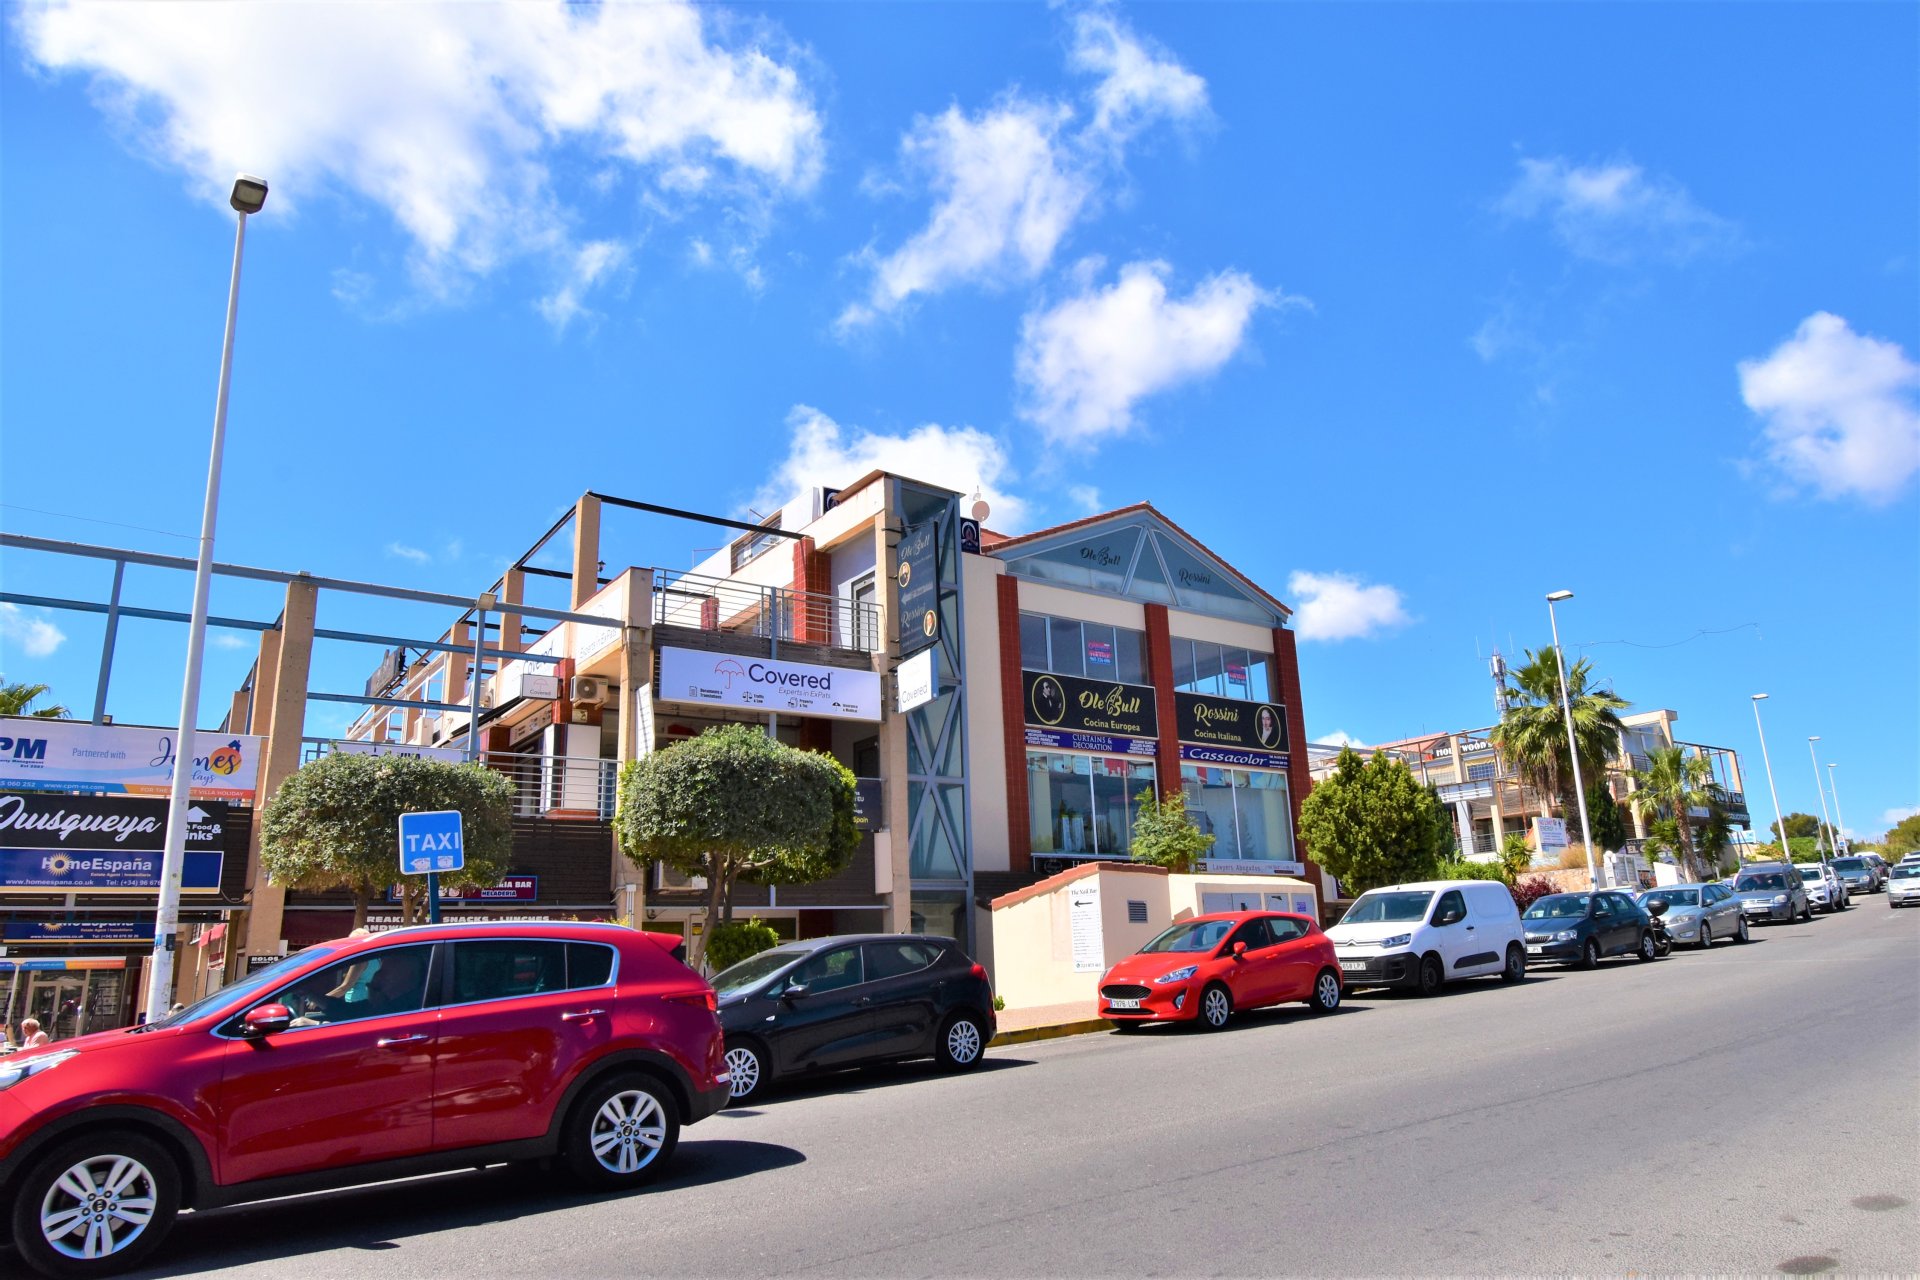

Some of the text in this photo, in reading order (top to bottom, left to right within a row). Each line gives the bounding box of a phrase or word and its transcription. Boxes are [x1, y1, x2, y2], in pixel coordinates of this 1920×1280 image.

[1080, 547, 1120, 566] Ole Bull
[1179, 568, 1210, 586] Rossini
[748, 663, 831, 690] Covered
[778, 687, 803, 696] Experts
[810, 691, 831, 699] ExPats
[902, 681, 928, 703] Covered
[1079, 687, 1140, 716] Ole Bull
[1193, 703, 1239, 727] Rossini
[1083, 717, 1141, 732] Cocina Europea
[1072, 734, 1105, 744] CURTAINS
[1194, 728, 1242, 742] Cocina Italiana
[72, 747, 126, 760] Partnered with
[1072, 741, 1112, 751] DECORATION
[1436, 741, 1493, 757] HOLWOOD'S
[1189, 748, 1267, 765] Cassacolor
[186, 831, 213, 840] inks
[212, 824, 221, 834] &
[406, 832, 460, 852] TAXI
[514, 881, 532, 889] BAR
